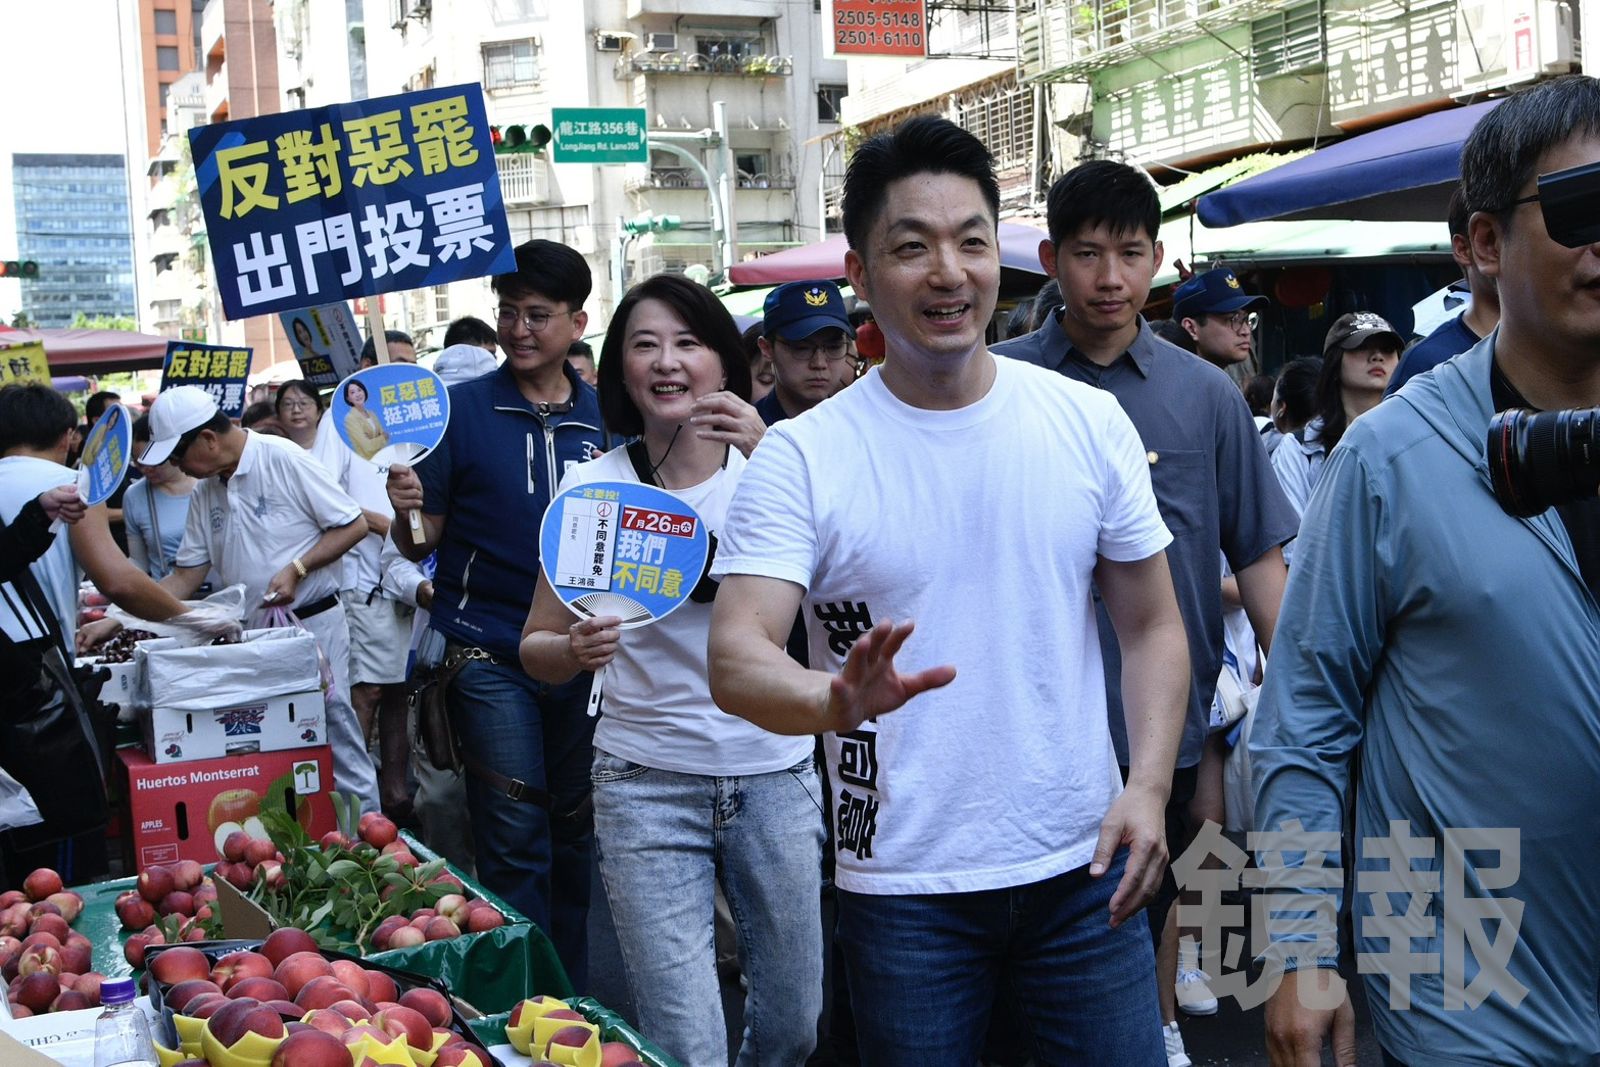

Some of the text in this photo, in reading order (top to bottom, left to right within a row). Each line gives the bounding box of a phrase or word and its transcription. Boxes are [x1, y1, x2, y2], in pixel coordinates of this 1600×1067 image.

[836, 10, 920, 27] 2505-5148
[837, 30, 921, 47] 2501-6110
[560, 120, 639, 136] 龍江路356巷
[215, 95, 480, 220] 反對惡罷
[597, 142, 608, 150] Rd.
[233, 182, 495, 307] 出門投票
[167, 350, 249, 378] 反對惡罷
[166, 383, 243, 411] 投票
[381, 378, 437, 405] 反惡罷
[383, 398, 441, 426] 挺鴻薇
[592, 519, 608, 577] 不同意罷免
[616, 529, 668, 566] 我們
[568, 576, 596, 587] 王鴻薇
[612, 560, 683, 598] 不同意
[137, 765, 260, 791] Huertos Montserrat
[141, 819, 163, 830] APPLES
